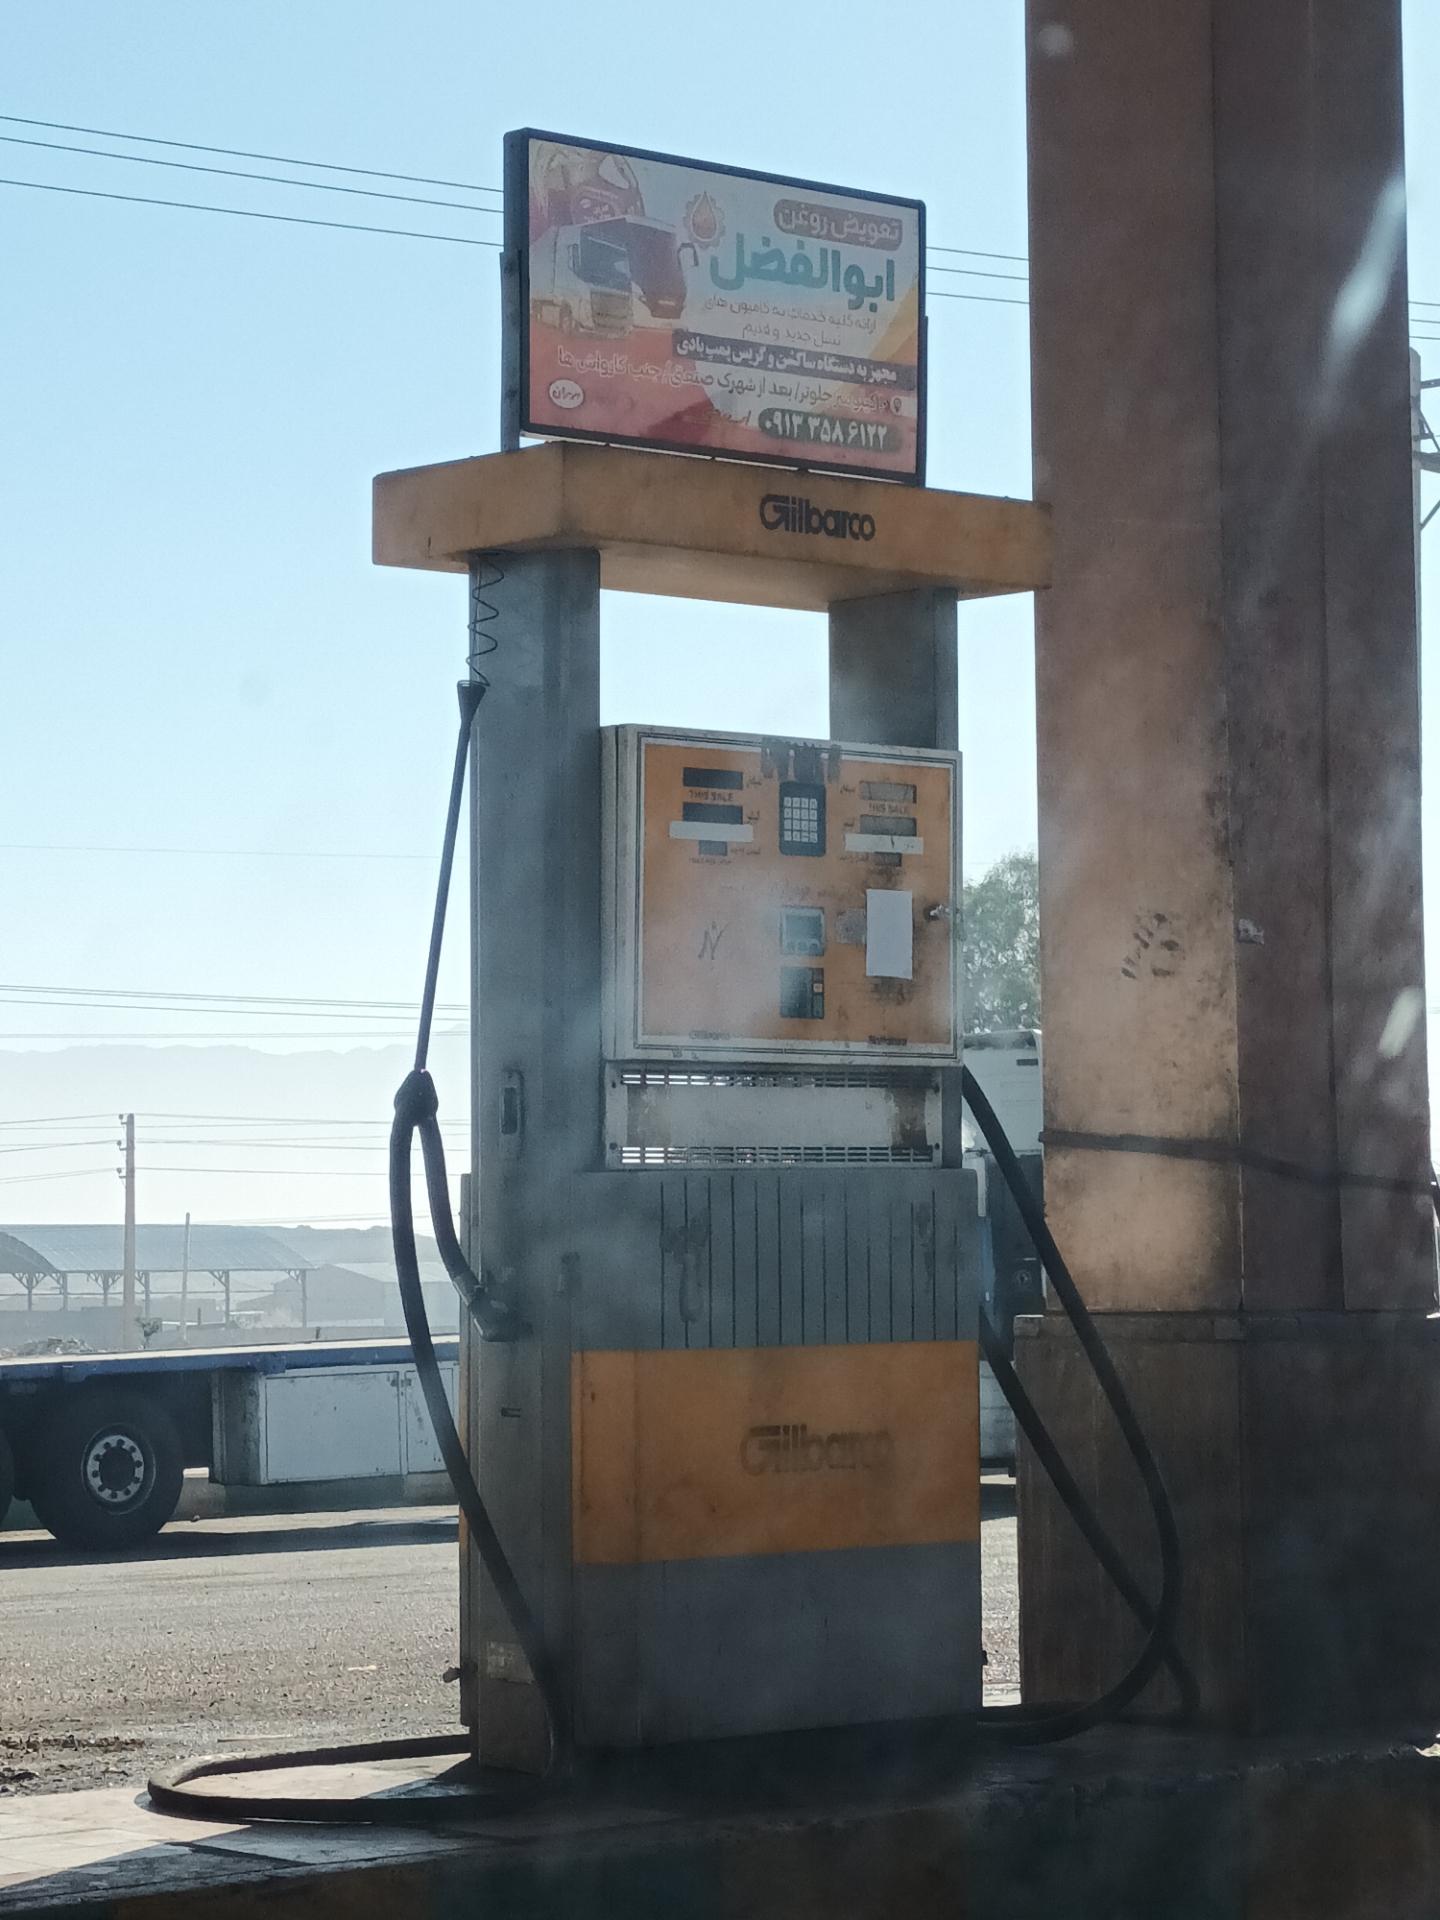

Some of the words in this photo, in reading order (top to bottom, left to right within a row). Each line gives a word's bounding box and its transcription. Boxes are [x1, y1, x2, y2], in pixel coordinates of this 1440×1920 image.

[778, 204, 829, 236] روغن
[831, 213, 900, 245] تعویض
[709, 232, 896, 313] ابوالفضل
[742, 322, 770, 338] قدیم
[772, 327, 780, 340] و
[786, 328, 811, 343] جدید
[813, 330, 841, 347] نسل
[676, 336, 705, 358] بادی
[705, 345, 731, 362] پمپ
[732, 346, 767, 366] گریس
[767, 353, 775, 369] و
[775, 349, 816, 370] ساکشن
[817, 354, 856, 375] دستگاه
[717, 371, 756, 395] شهرک
[868, 365, 897, 384] مجهز
[759, 493, 877, 542] Gilbarco
[739, 1423, 896, 1477] Gilbarco
